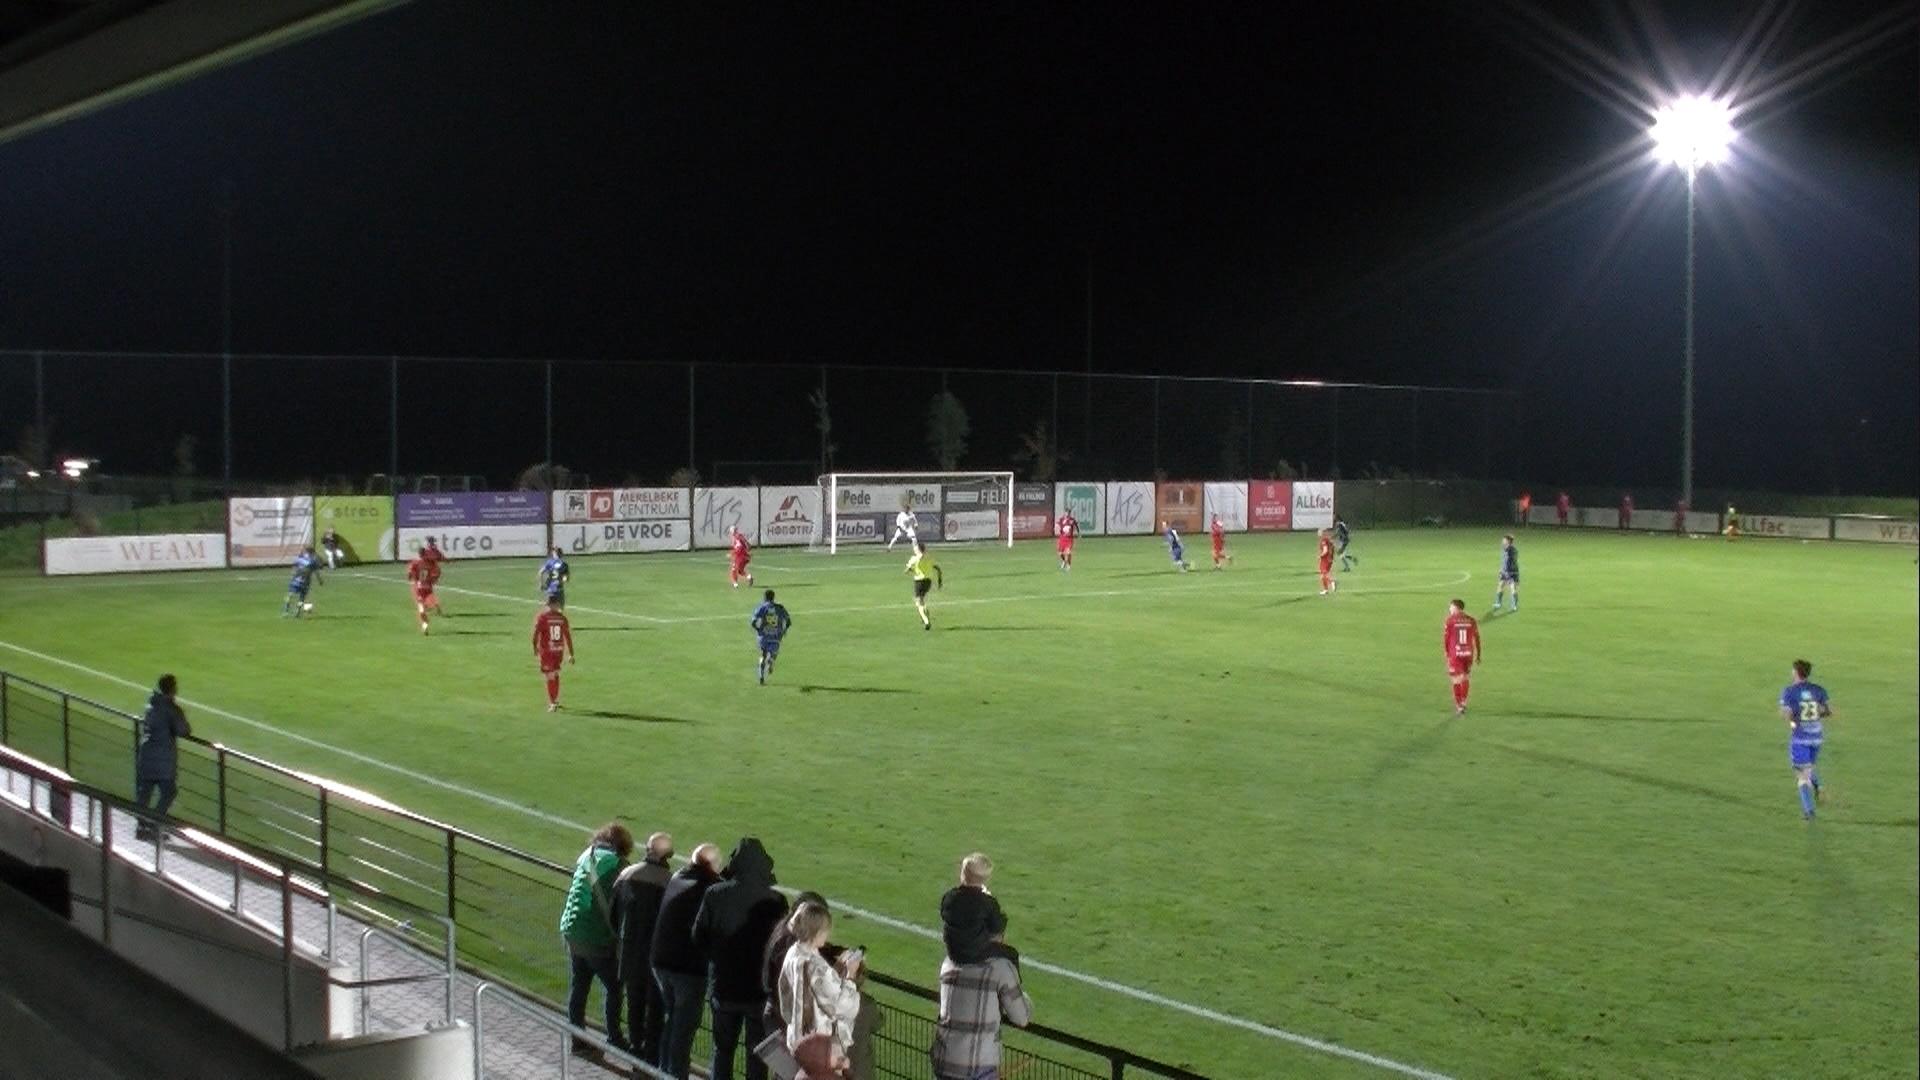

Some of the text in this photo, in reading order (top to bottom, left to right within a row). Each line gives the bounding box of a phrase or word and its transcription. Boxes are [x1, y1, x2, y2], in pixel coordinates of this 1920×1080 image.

[619, 491, 679, 502] MERELBEKE
[1296, 495, 1331, 509] ALLfac
[619, 503, 680, 515] CENTRUM
[604, 523, 672, 539] DE VROE
[836, 522, 873, 537] Hubo
[119, 540, 207, 562] WEAM
[407, 533, 493, 554] atrea
[549, 625, 561, 641] 18
[1459, 629, 1467, 645] 11
[1798, 701, 1819, 721] 23
